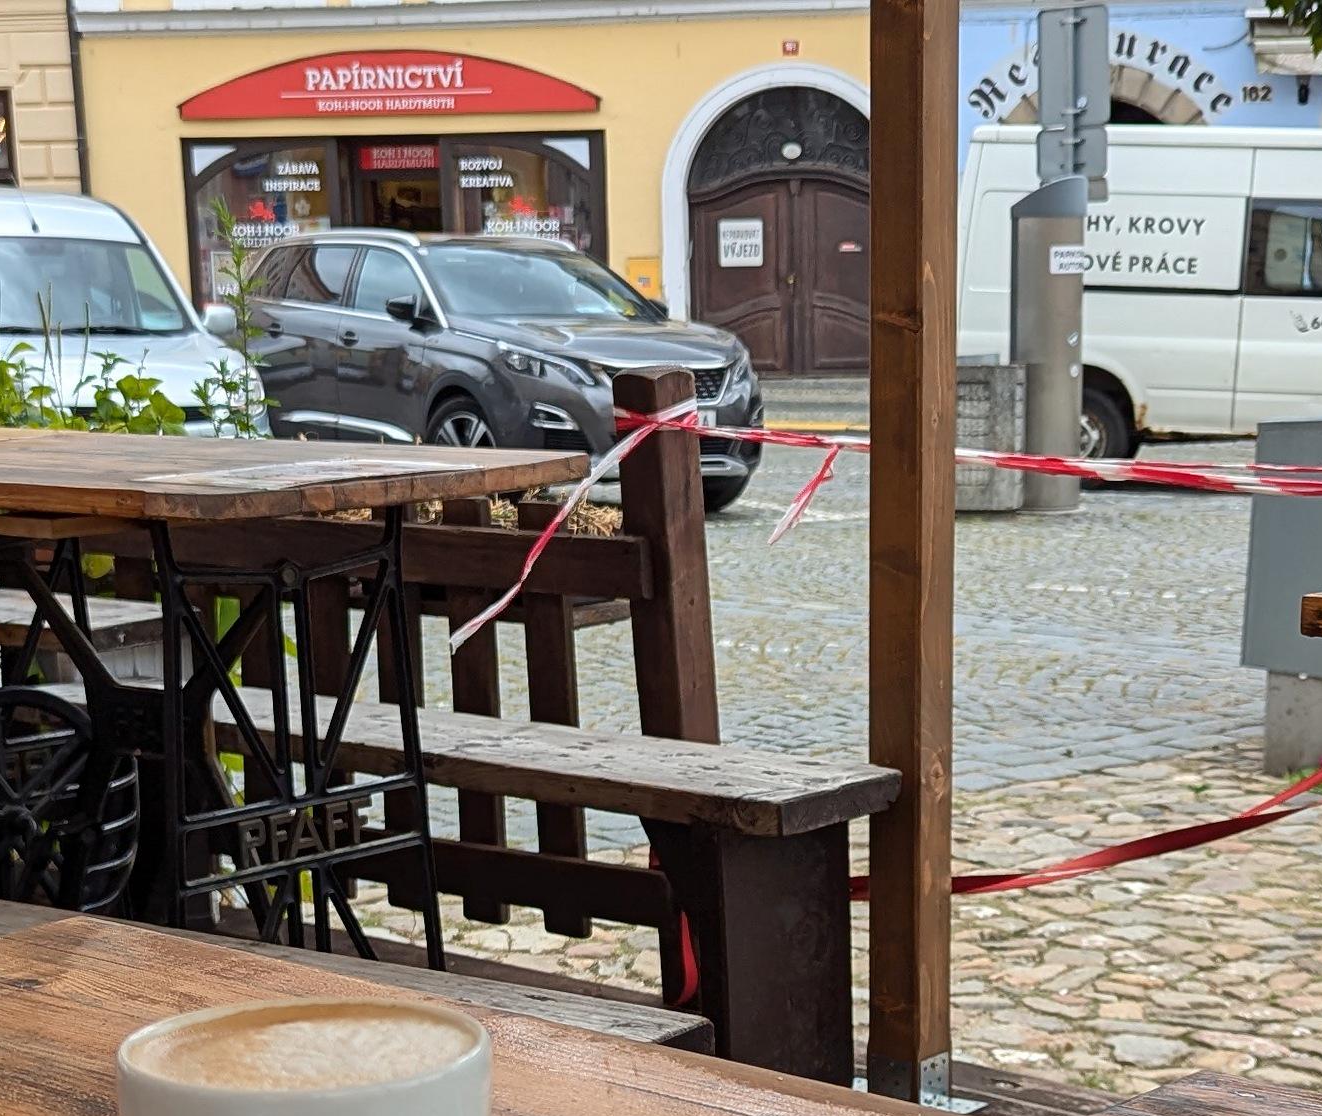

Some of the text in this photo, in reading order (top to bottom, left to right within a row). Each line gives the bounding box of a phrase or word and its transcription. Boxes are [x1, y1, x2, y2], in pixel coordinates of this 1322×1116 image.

[305, 58, 465, 92] PAPÍRNICTVÍ
[386, 97, 455, 110] HARDTMUTH
[278, 160, 319, 175] ZÁBAVA
[460, 158, 502, 171] ROZVOJ
[264, 179, 321, 192] INSPIRACE
[461, 175, 513, 188] KREATIVA
[1128, 215, 1206, 236] KROVY
[723, 241, 760, 258] VÝJEZD
[1128, 252, 1198, 275] PRÁCE
